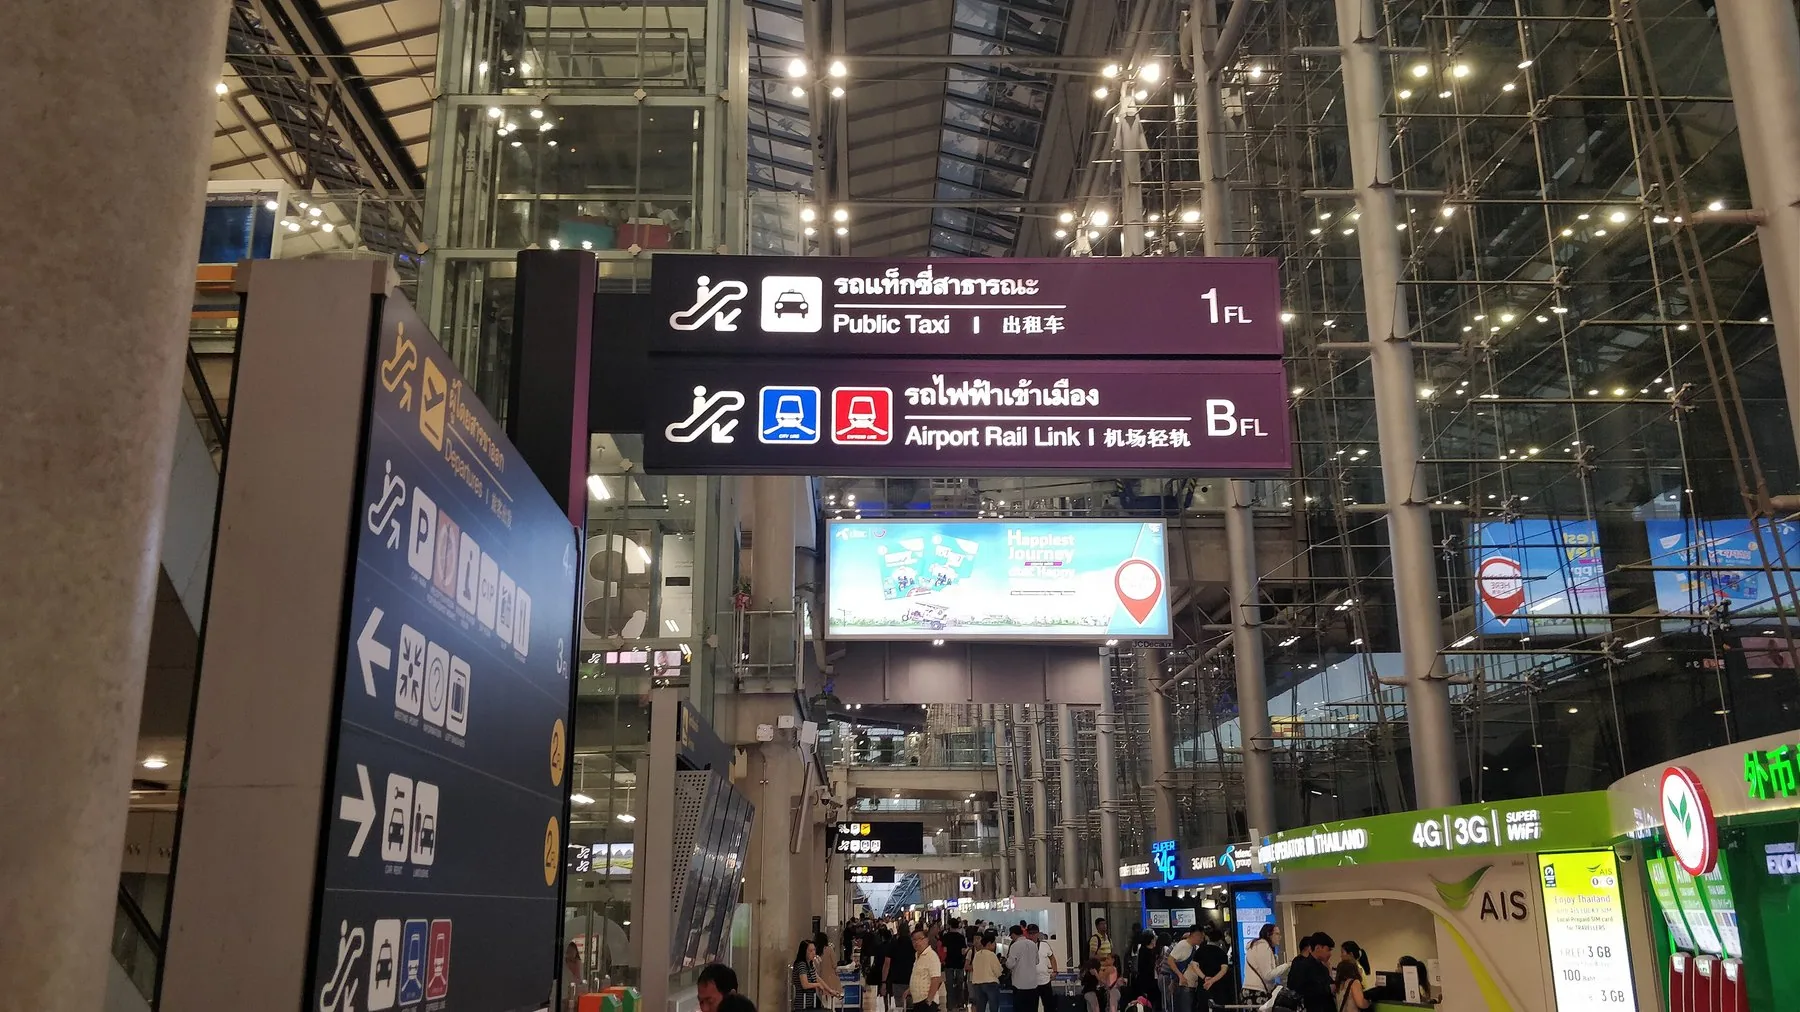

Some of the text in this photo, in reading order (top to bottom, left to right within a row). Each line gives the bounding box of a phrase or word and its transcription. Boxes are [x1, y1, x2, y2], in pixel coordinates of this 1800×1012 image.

[833, 265, 1040, 296] รถแท็กซี่สาธารณะ
[833, 314, 950, 334] Public Taxi
[1002, 315, 1066, 335] 出租车
[904, 374, 1100, 406] รถไฟฟ้าเข้าเมือง
[904, 425, 1081, 450] Airport Rail Link
[1103, 428, 1192, 448] 机场轻轨
[444, 438, 484, 498] Departures
[415, 507, 429, 554] P
[1007, 528, 1076, 548] Happiest
[1007, 546, 1075, 564] Journey
[1132, 641, 1172, 649] JCDecaux
[1744, 743, 1800, 800] 外币
[1506, 810, 1538, 823] SUPER
[1412, 820, 1442, 848] 4G
[1455, 816, 1489, 845] 3G
[1507, 822, 1540, 841] WiFi
[1152, 841, 1175, 852] SUPER
[1315, 828, 1366, 855] THAILAND
[1158, 850, 1176, 883] 4G
[1480, 890, 1527, 920] AIS
[1554, 895, 1611, 905] Enjoy Thailand
[1588, 945, 1594, 958] 3
[1597, 945, 1612, 958] GB
[1563, 969, 1581, 982] 100
[1601, 989, 1625, 1002] 3 GB
